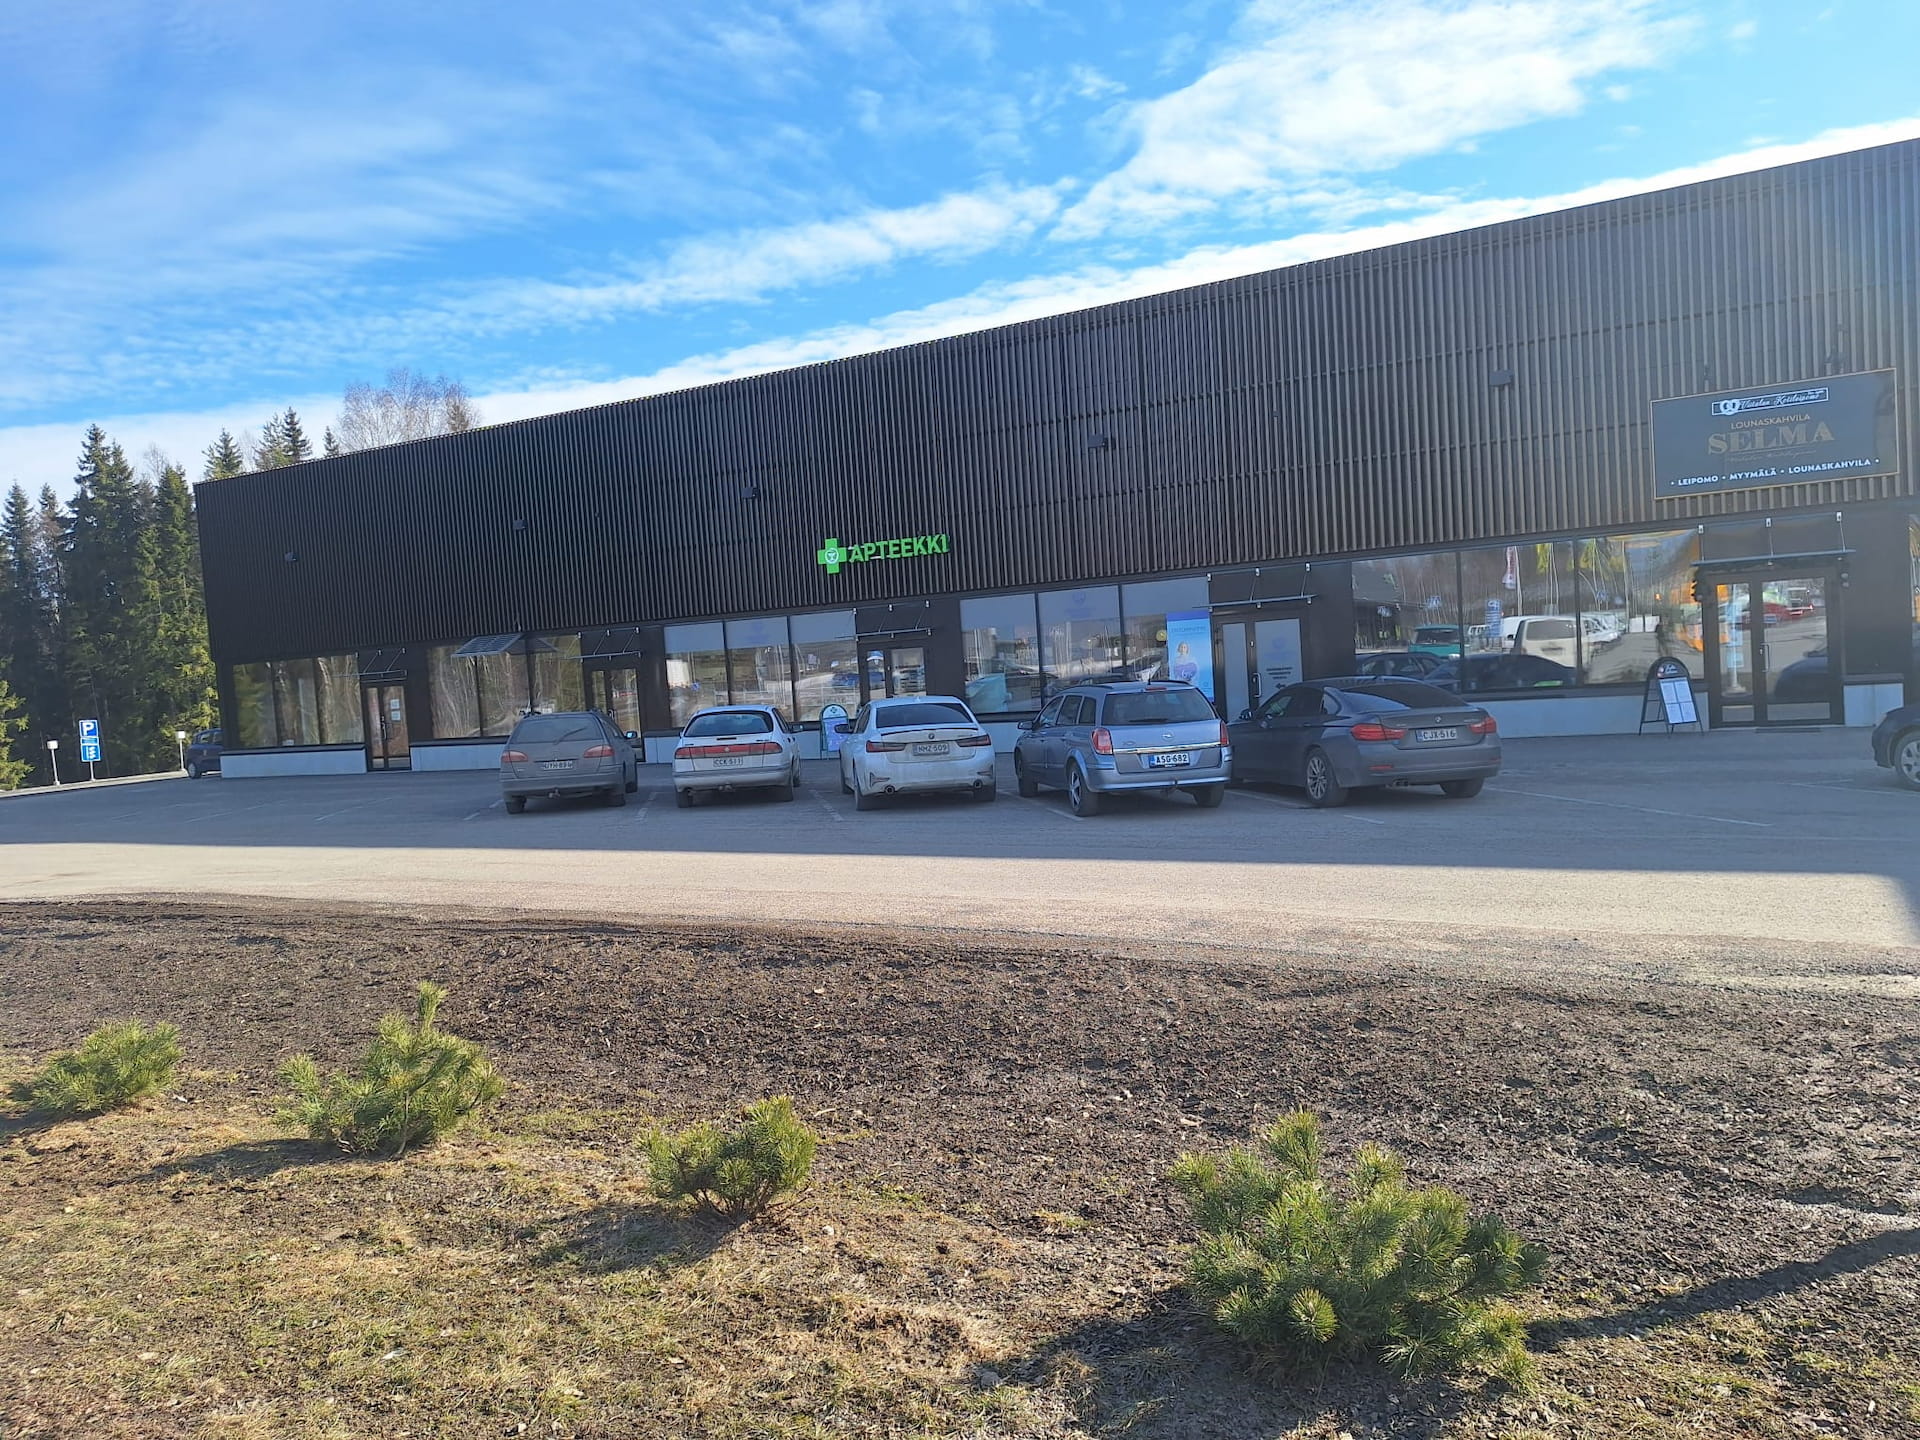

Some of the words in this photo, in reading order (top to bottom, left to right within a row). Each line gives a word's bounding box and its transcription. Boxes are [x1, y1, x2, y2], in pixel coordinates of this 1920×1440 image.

[1731, 414, 1811, 429] LOUNASKAHVILA
[1707, 423, 1835, 455] SELMA
[1678, 475, 1718, 486] LEIPOMO
[1729, 468, 1777, 481] MYYMÄLÄ
[1788, 458, 1871, 474] LOUNASKAHVILA
[849, 533, 949, 563] APTEEKKI
[83, 722, 94, 736] P
[1156, 754, 1187, 764] ASG-682
